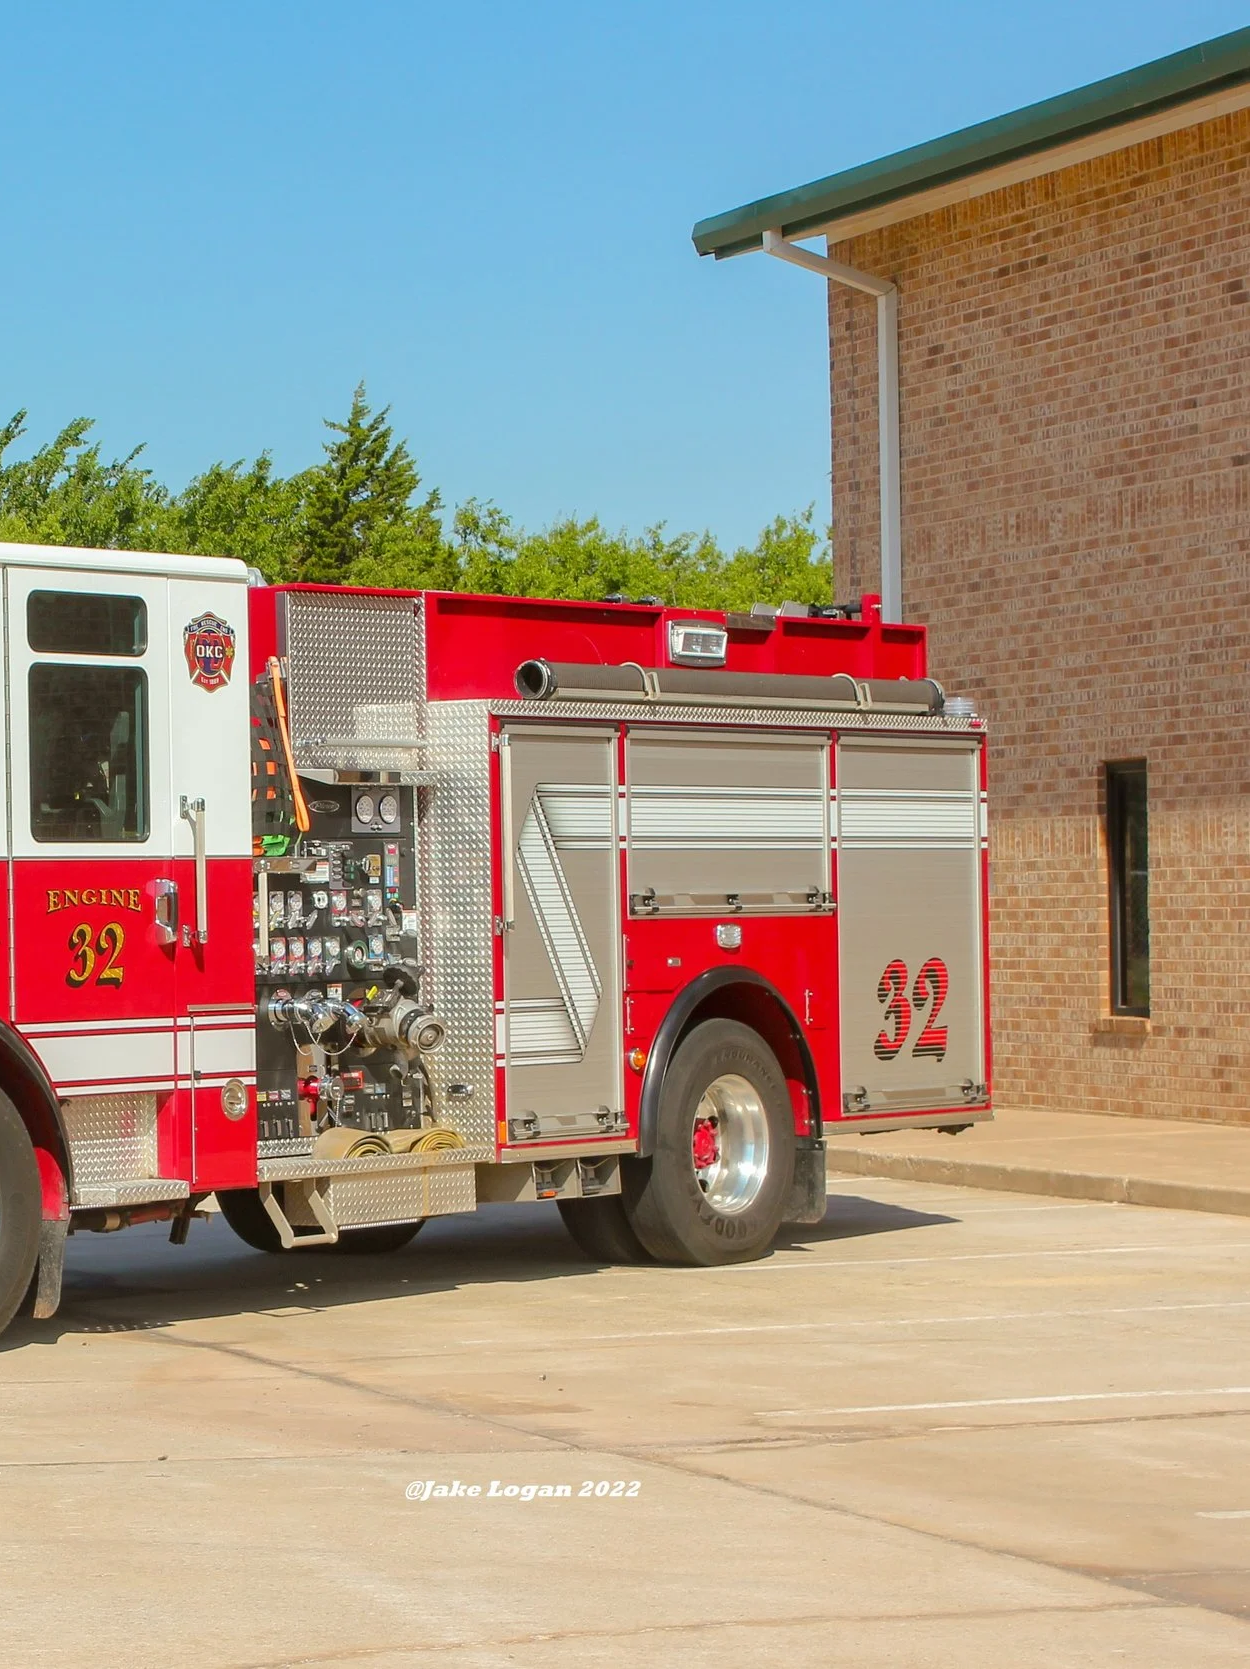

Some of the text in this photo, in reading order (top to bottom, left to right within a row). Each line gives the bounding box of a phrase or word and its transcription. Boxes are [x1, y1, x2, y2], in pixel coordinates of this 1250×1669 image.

[196, 645, 223, 658] OKC
[47, 889, 142, 913] ENGINE
[66, 921, 125, 989] 32
[873, 957, 949, 1062] 32
